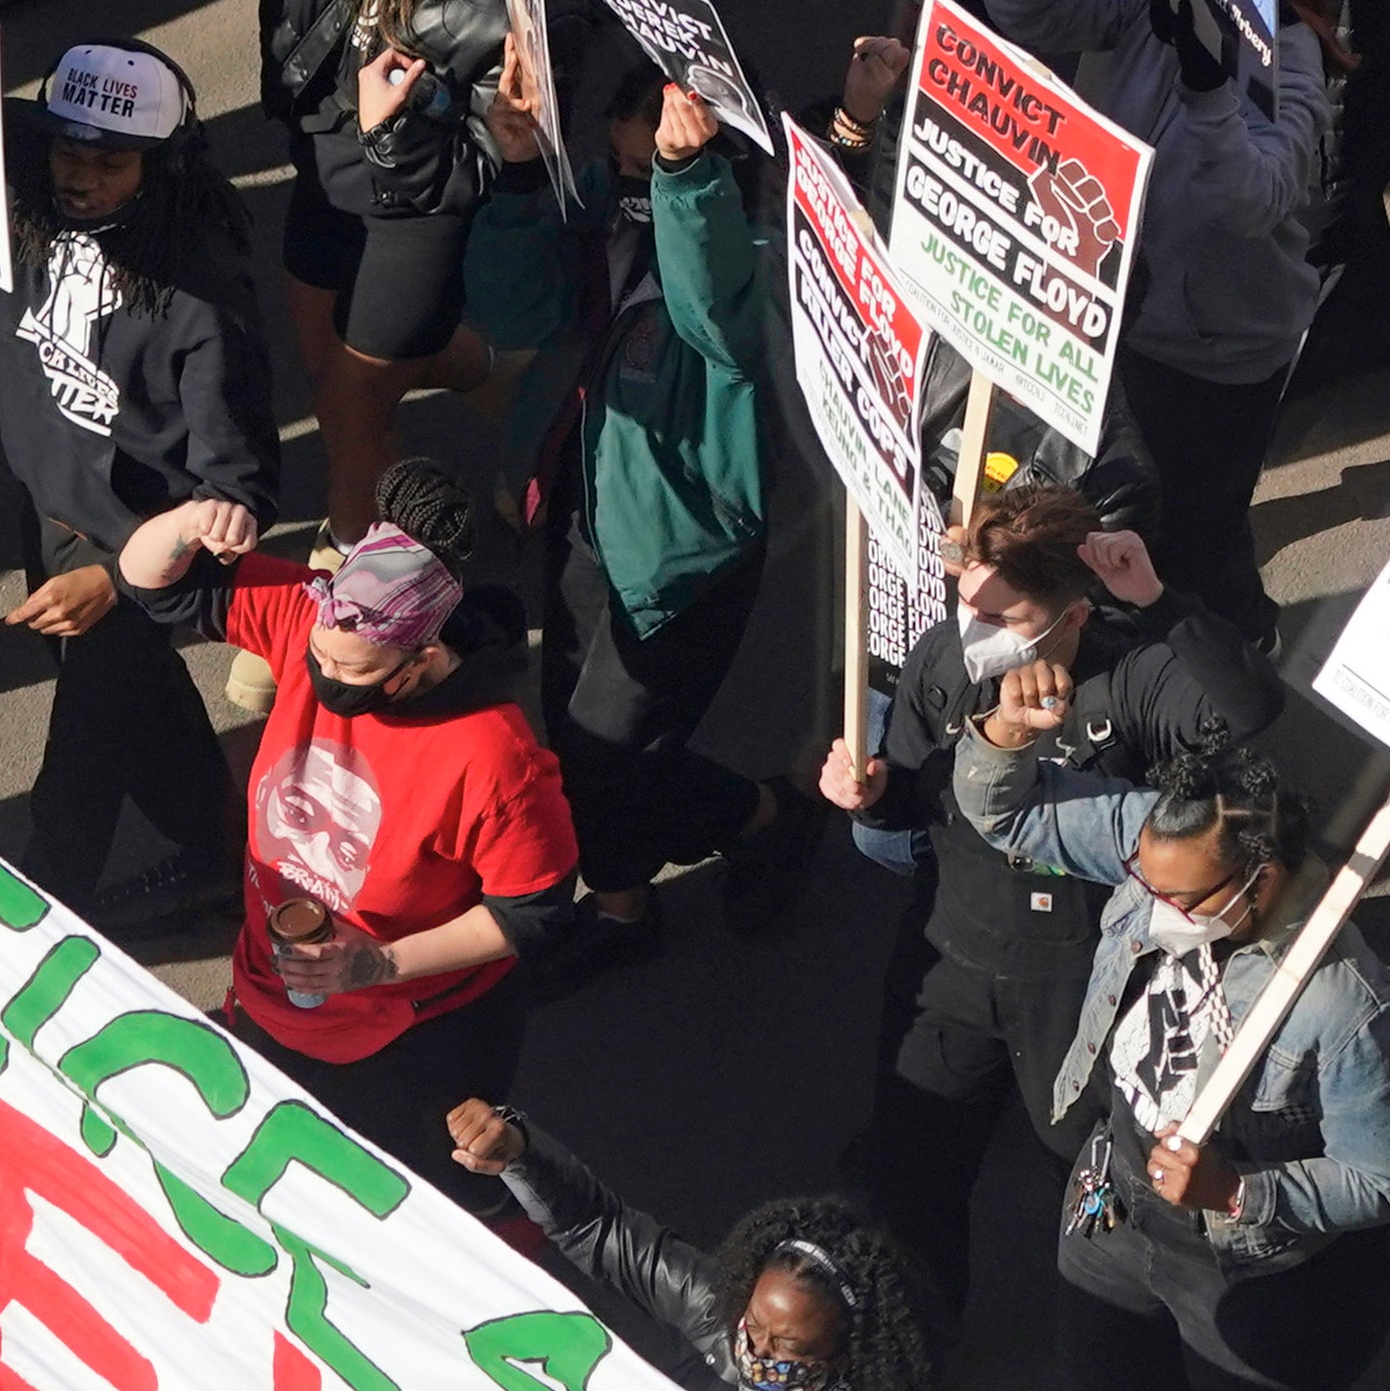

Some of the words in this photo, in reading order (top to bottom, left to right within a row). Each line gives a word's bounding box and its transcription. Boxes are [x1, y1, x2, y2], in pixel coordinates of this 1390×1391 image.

[67, 68, 97, 91] BLACK
[103, 78, 138, 100] LIVES
[936, 24, 1066, 134] CONVICT
[1230, 4, 1272, 68] Arbery
[62, 83, 136, 118] MATTER
[928, 58, 1062, 175] CHAUVIN
[796, 148, 858, 263] JUSTICE
[861, 257, 896, 323] FOR
[913, 117, 1019, 213] JUSTICE
[1027, 203, 1078, 257] FOR
[796, 165, 857, 286] GEORGE
[859, 279, 914, 379] FLOYD
[799, 229, 871, 364] CONVICT
[907, 165, 1009, 267] GEORGE
[1014, 250, 1108, 339] FLOYD
[920, 233, 1003, 312] JUSTICE
[1008, 298, 1051, 347] FOR
[1058, 336, 1099, 385] ALL
[951, 288, 1029, 366] STOLEN
[1036, 354, 1095, 414] LIVES
[800, 273, 855, 393] KILLER
[856, 386, 908, 480] COPS
[822, 392, 858, 471] KEUNG
[862, 469, 871, 491] &
[878, 495, 913, 560] THAO
[874, 464, 910, 521] LANE
[869, 563, 905, 601] ORGE
[869, 586, 905, 625] ORGE
[919, 546, 944, 579] OYD
[919, 569, 946, 602] OYD
[868, 632, 906, 669] ORGE
[869, 609, 906, 648] ORGE
